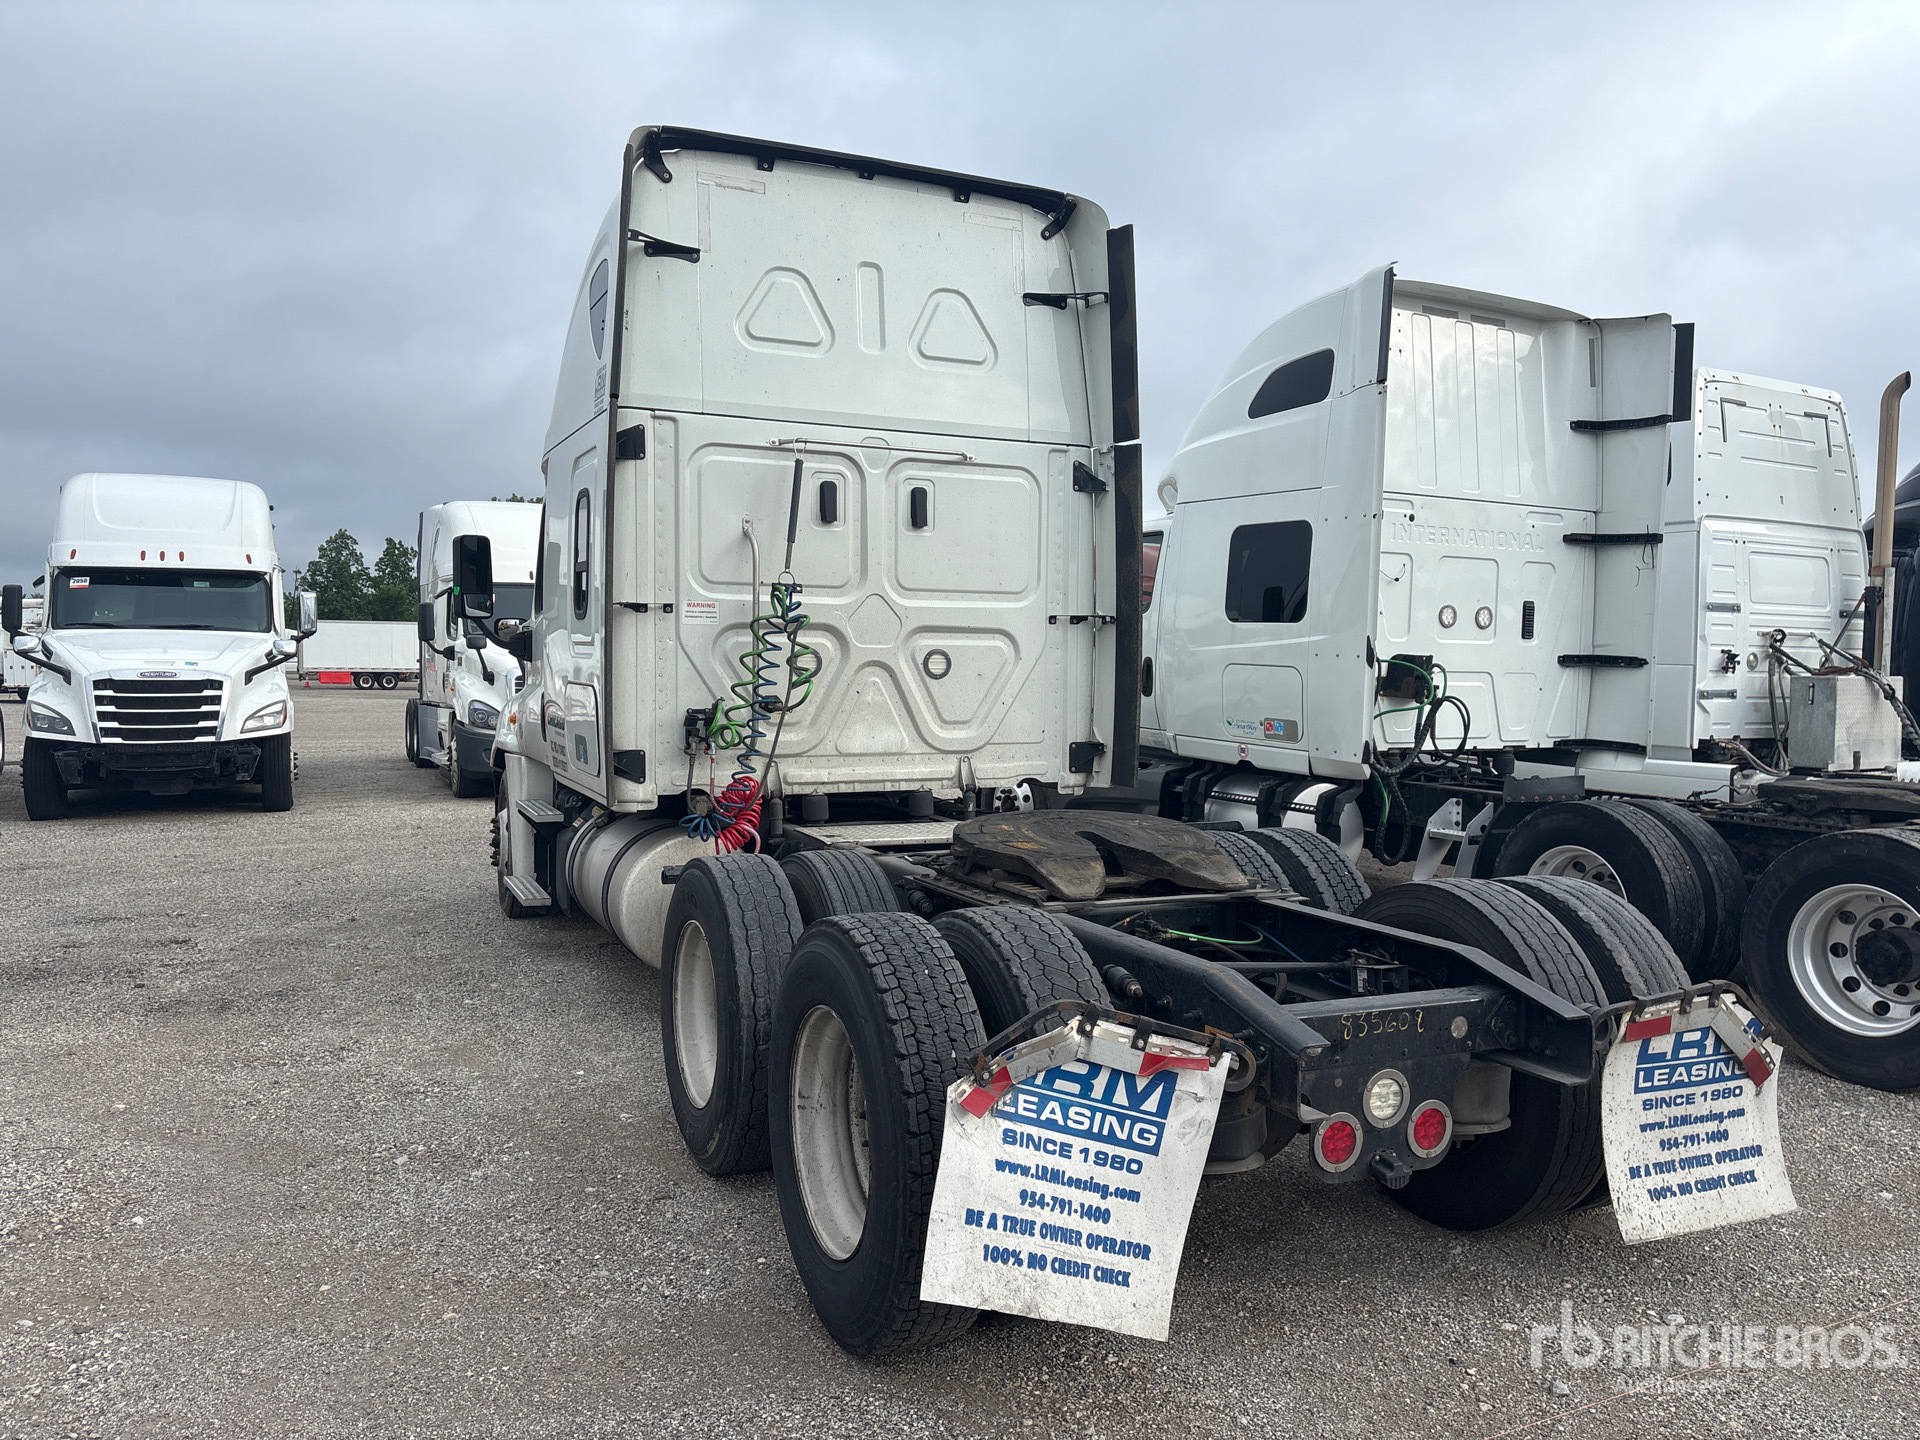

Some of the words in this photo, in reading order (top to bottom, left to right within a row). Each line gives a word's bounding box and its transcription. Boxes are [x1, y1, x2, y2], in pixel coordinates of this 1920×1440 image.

[1390, 522, 1545, 552] INTERNATIONAL
[1643, 1093, 1696, 1111] SINCE
[1700, 1085, 1744, 1103] 1980
[997, 1092, 1159, 1147] LEASING
[1639, 1108, 1745, 1133] www.LRMLeasing.com
[1002, 1128, 1073, 1159] SINCE
[1079, 1147, 1143, 1175] 1980
[1659, 1129, 1729, 1151] 954-791-1400
[1629, 1166, 1642, 1179] BE
[1644, 1164, 1651, 1177] A
[1652, 1160, 1677, 1176] TRUE
[1679, 1153, 1714, 1170] OWNER
[1715, 1145, 1763, 1164] OPERATOR
[995, 1159, 1141, 1203] www.LRMLeasing.com
[1647, 1185, 1677, 1201] 100%
[1677, 1182, 1693, 1196] NO
[1694, 1175, 1727, 1193] CREDIT
[1728, 1169, 1757, 1187] CHECK
[1019, 1189, 1111, 1224] 954-791-1400
[965, 1208, 984, 1227] BE
[987, 1213, 997, 1231] A
[1002, 1215, 1036, 1237] TRUE
[1040, 1222, 1082, 1247] OWNER
[1086, 1233, 1151, 1261] OPERATOR
[983, 1244, 1023, 1267] 100%
[1028, 1252, 1047, 1271] NO
[1051, 1257, 1091, 1280] CREDIT
[1094, 1266, 1131, 1288] CHECK
